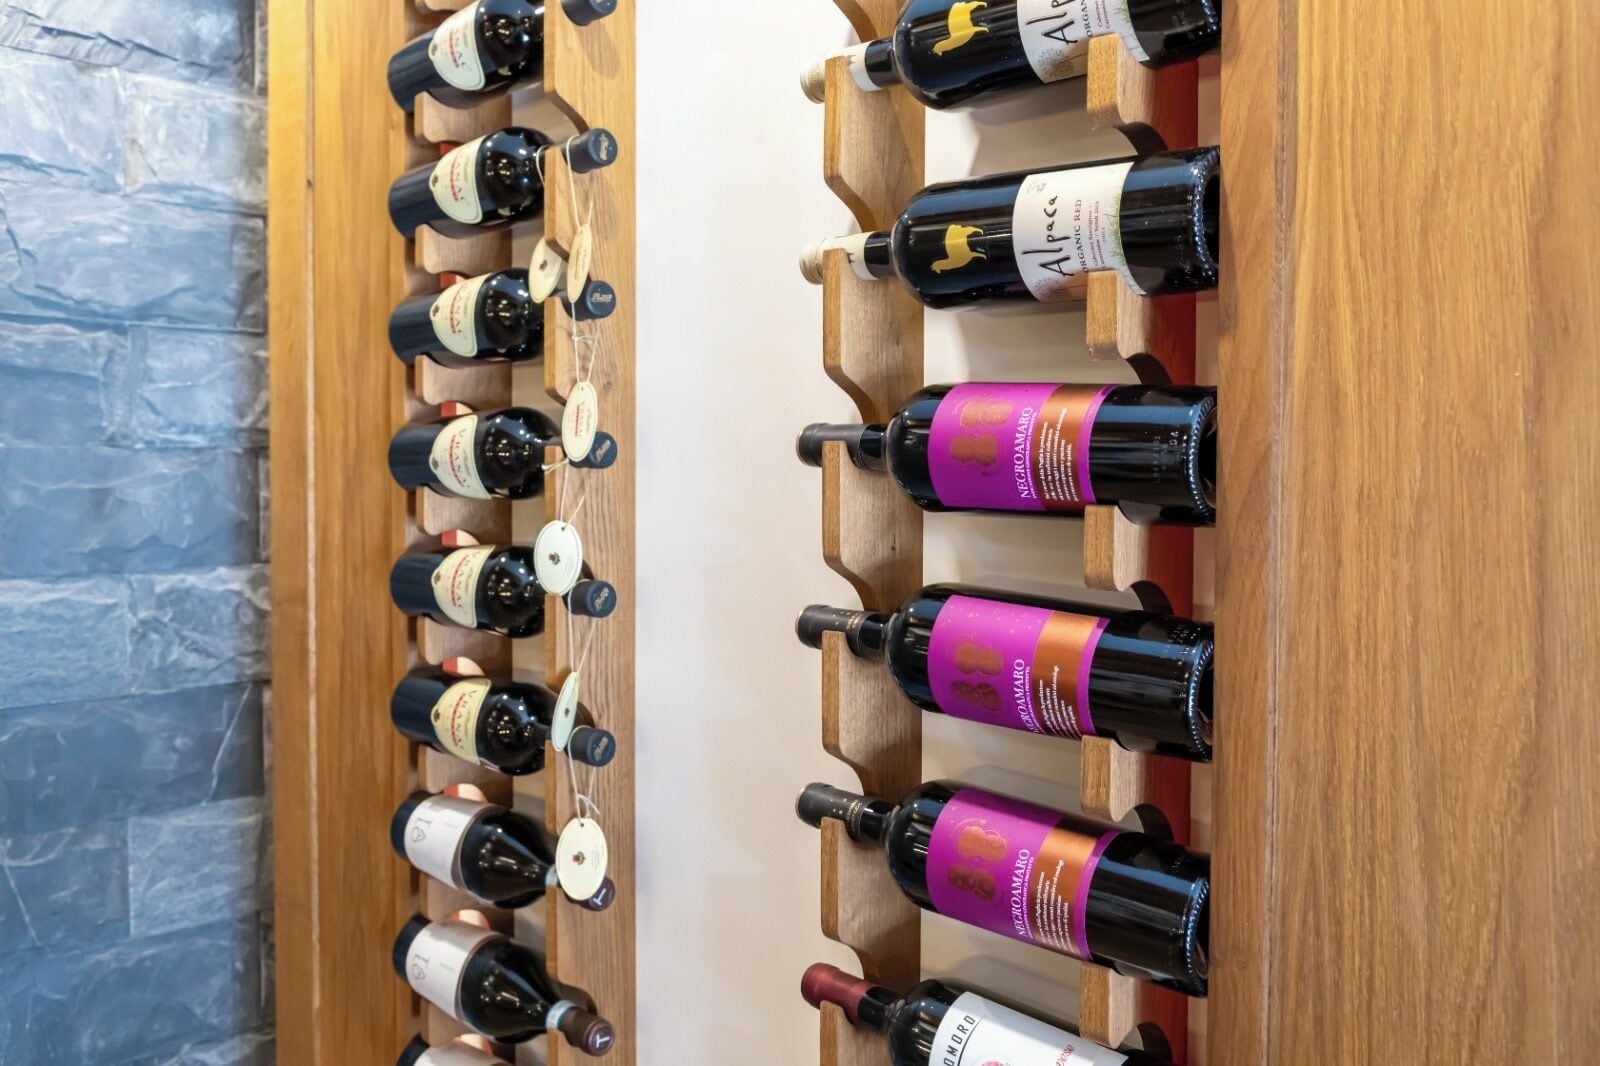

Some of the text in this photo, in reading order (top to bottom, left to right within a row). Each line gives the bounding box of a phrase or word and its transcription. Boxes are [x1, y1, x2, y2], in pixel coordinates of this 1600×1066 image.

[1021, 195, 1075, 277] Alpaca
[1073, 199, 1089, 273] ORGANIC RED
[1013, 407, 1033, 498] NEGROAMARO
[1011, 849, 1030, 938] NEGROAMARO
[942, 1015, 975, 1066] OMORO
